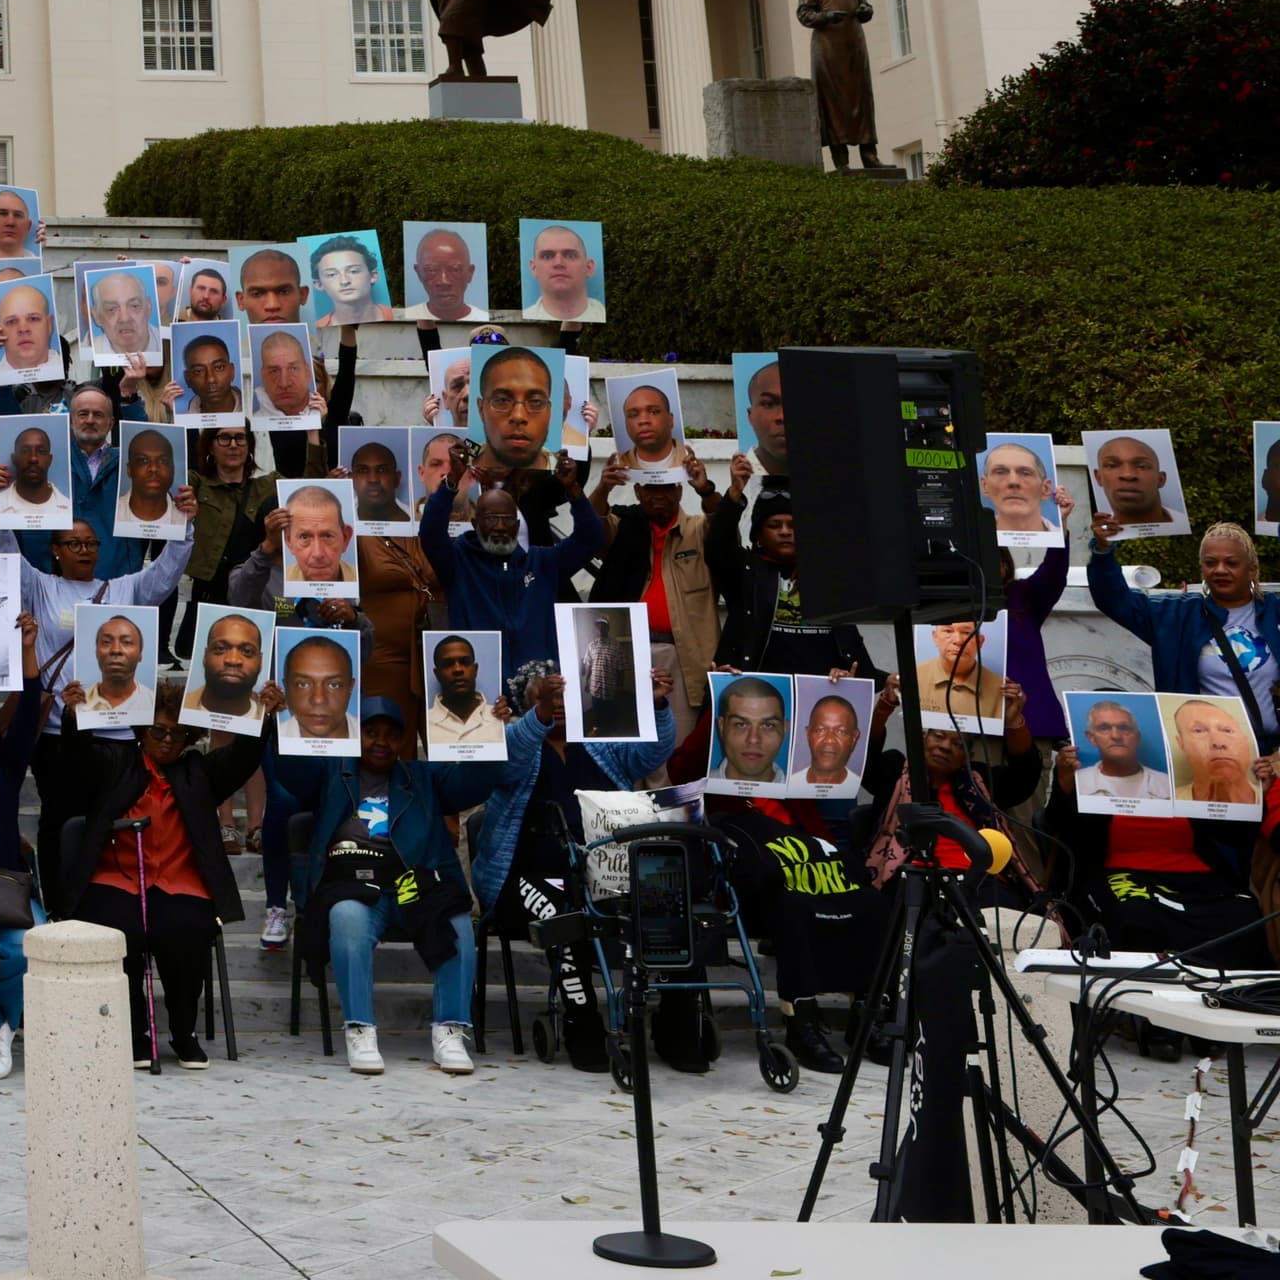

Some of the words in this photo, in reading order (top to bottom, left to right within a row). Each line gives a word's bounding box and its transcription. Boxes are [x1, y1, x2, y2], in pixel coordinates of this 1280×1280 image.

[520, 877, 557, 920] EVER
[903, 929, 914, 958] JOBY
[562, 976, 588, 1006] UP
